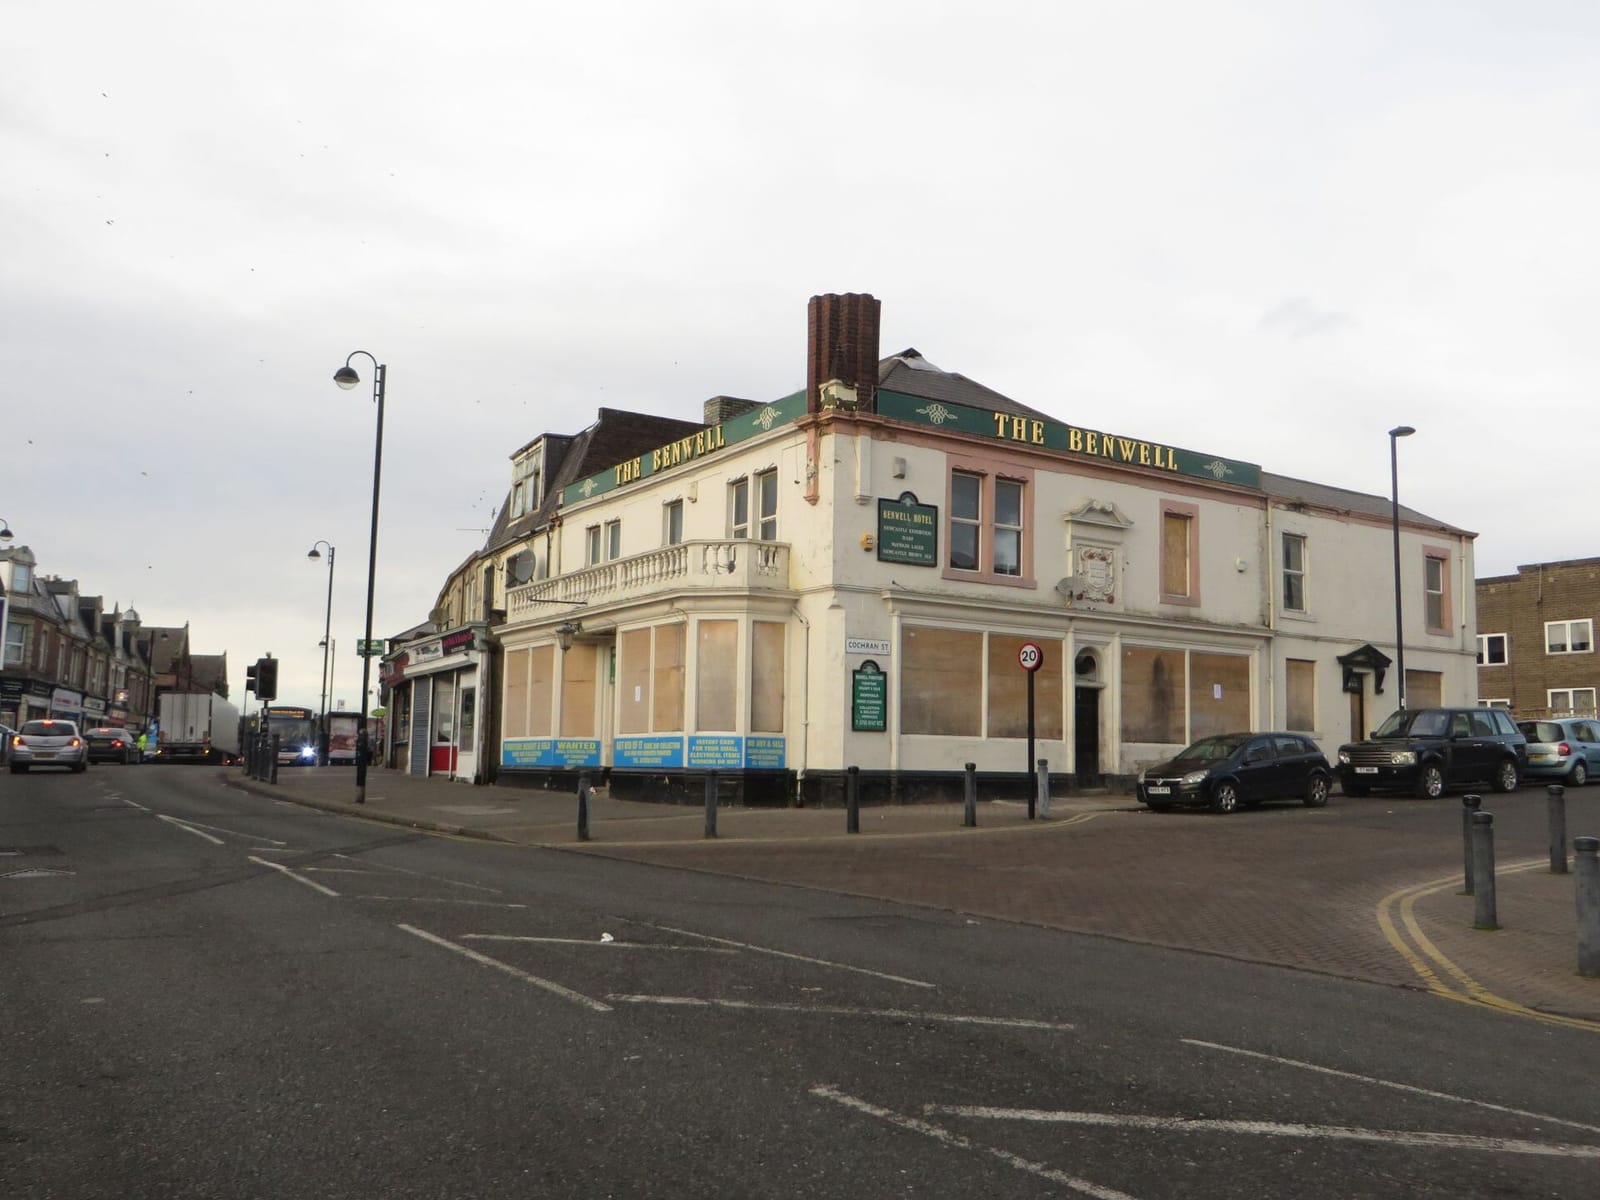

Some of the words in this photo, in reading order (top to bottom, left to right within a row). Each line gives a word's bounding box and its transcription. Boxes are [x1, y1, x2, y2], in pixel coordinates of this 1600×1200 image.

[994, 412, 1045, 445] THE
[1068, 428, 1178, 471] BENWELL
[615, 456, 641, 486] THE
[653, 425, 725, 472] BENWELL
[883, 510, 911, 522] BENWELL
[913, 513, 932, 525] HOTEL
[848, 641, 879, 650] COCHRAN
[881, 643, 889, 651] ST
[1021, 650, 1037, 662] 20
[557, 742, 596, 750] WANTED
